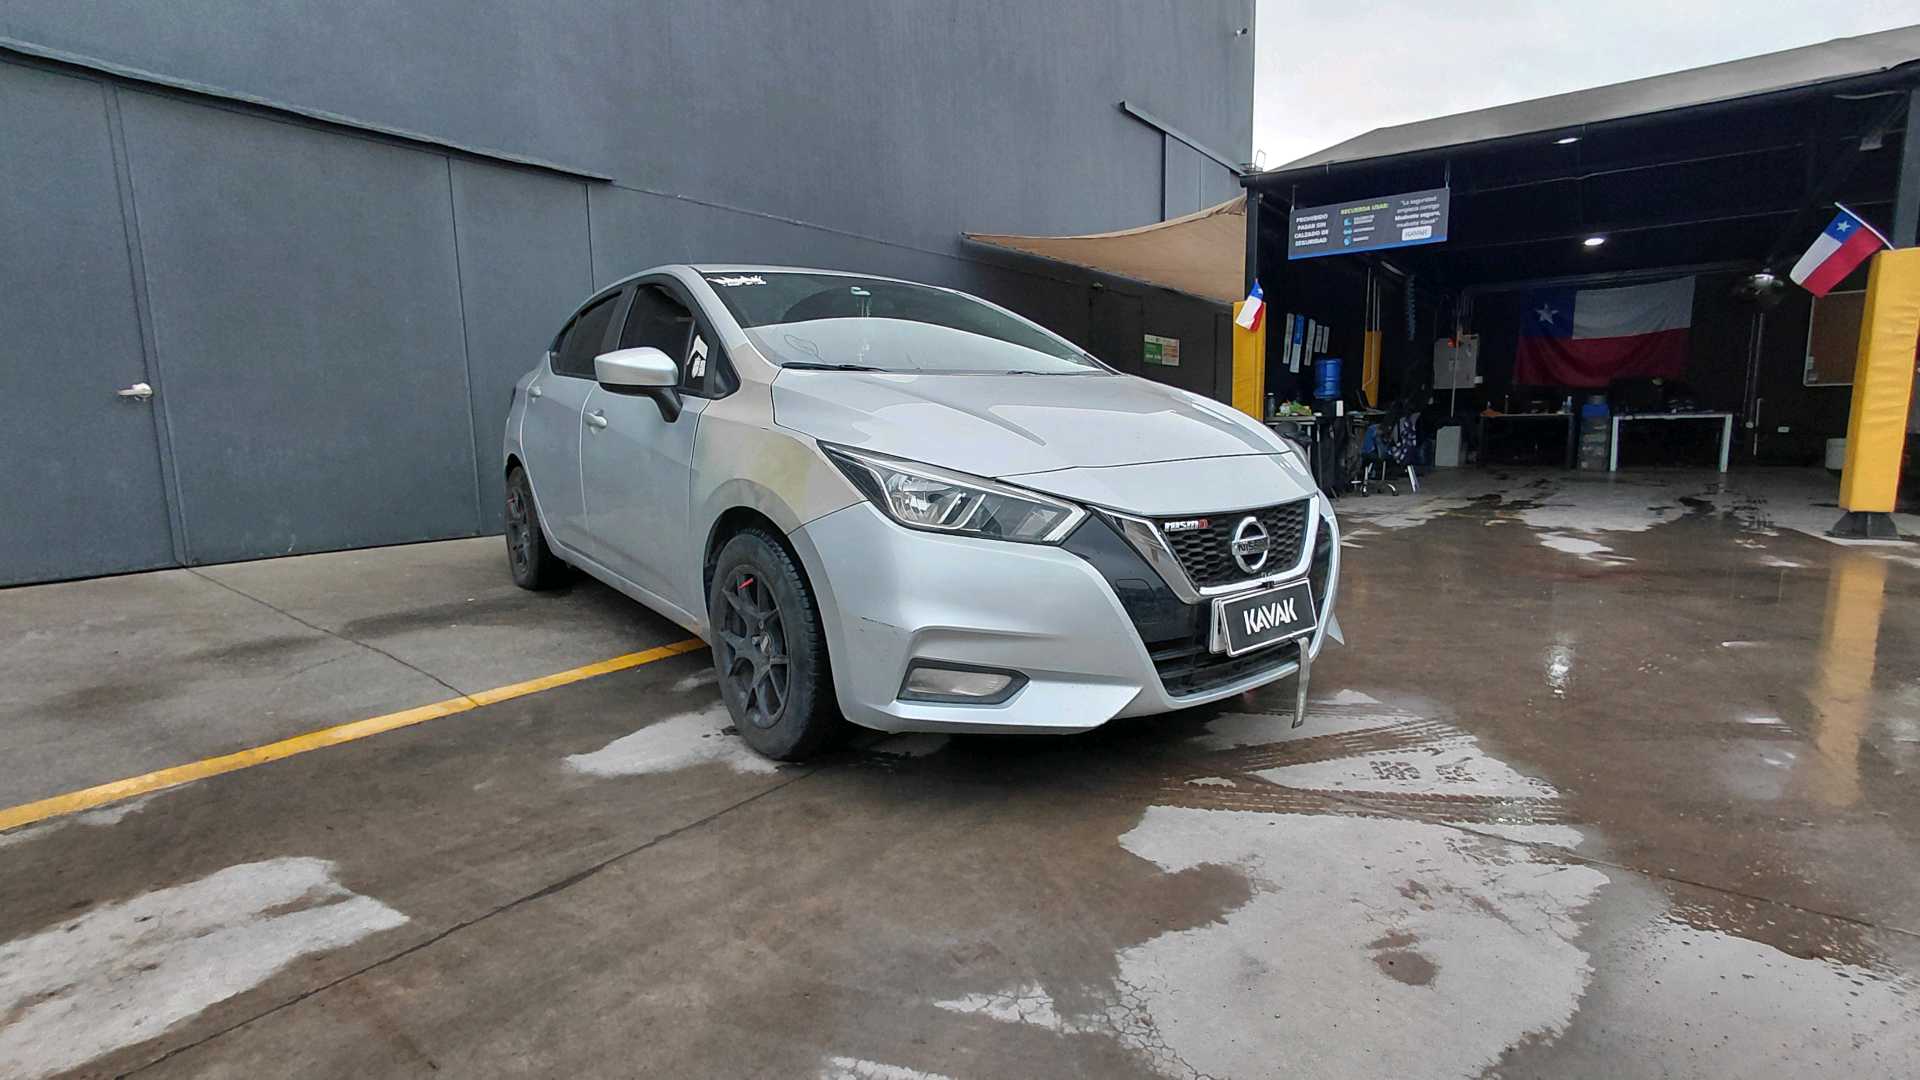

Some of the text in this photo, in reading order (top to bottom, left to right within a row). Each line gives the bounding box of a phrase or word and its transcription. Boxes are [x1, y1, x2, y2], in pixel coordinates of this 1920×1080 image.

[1340, 206, 1370, 215] RECUERDA
[1296, 213, 1328, 223] PROHIBIDO
[1297, 223, 1315, 231] PASAR
[1294, 230, 1320, 239] CALZADO
[1295, 238, 1327, 247] SEGURIDAD
[1243, 597, 1298, 636] KAVAK
